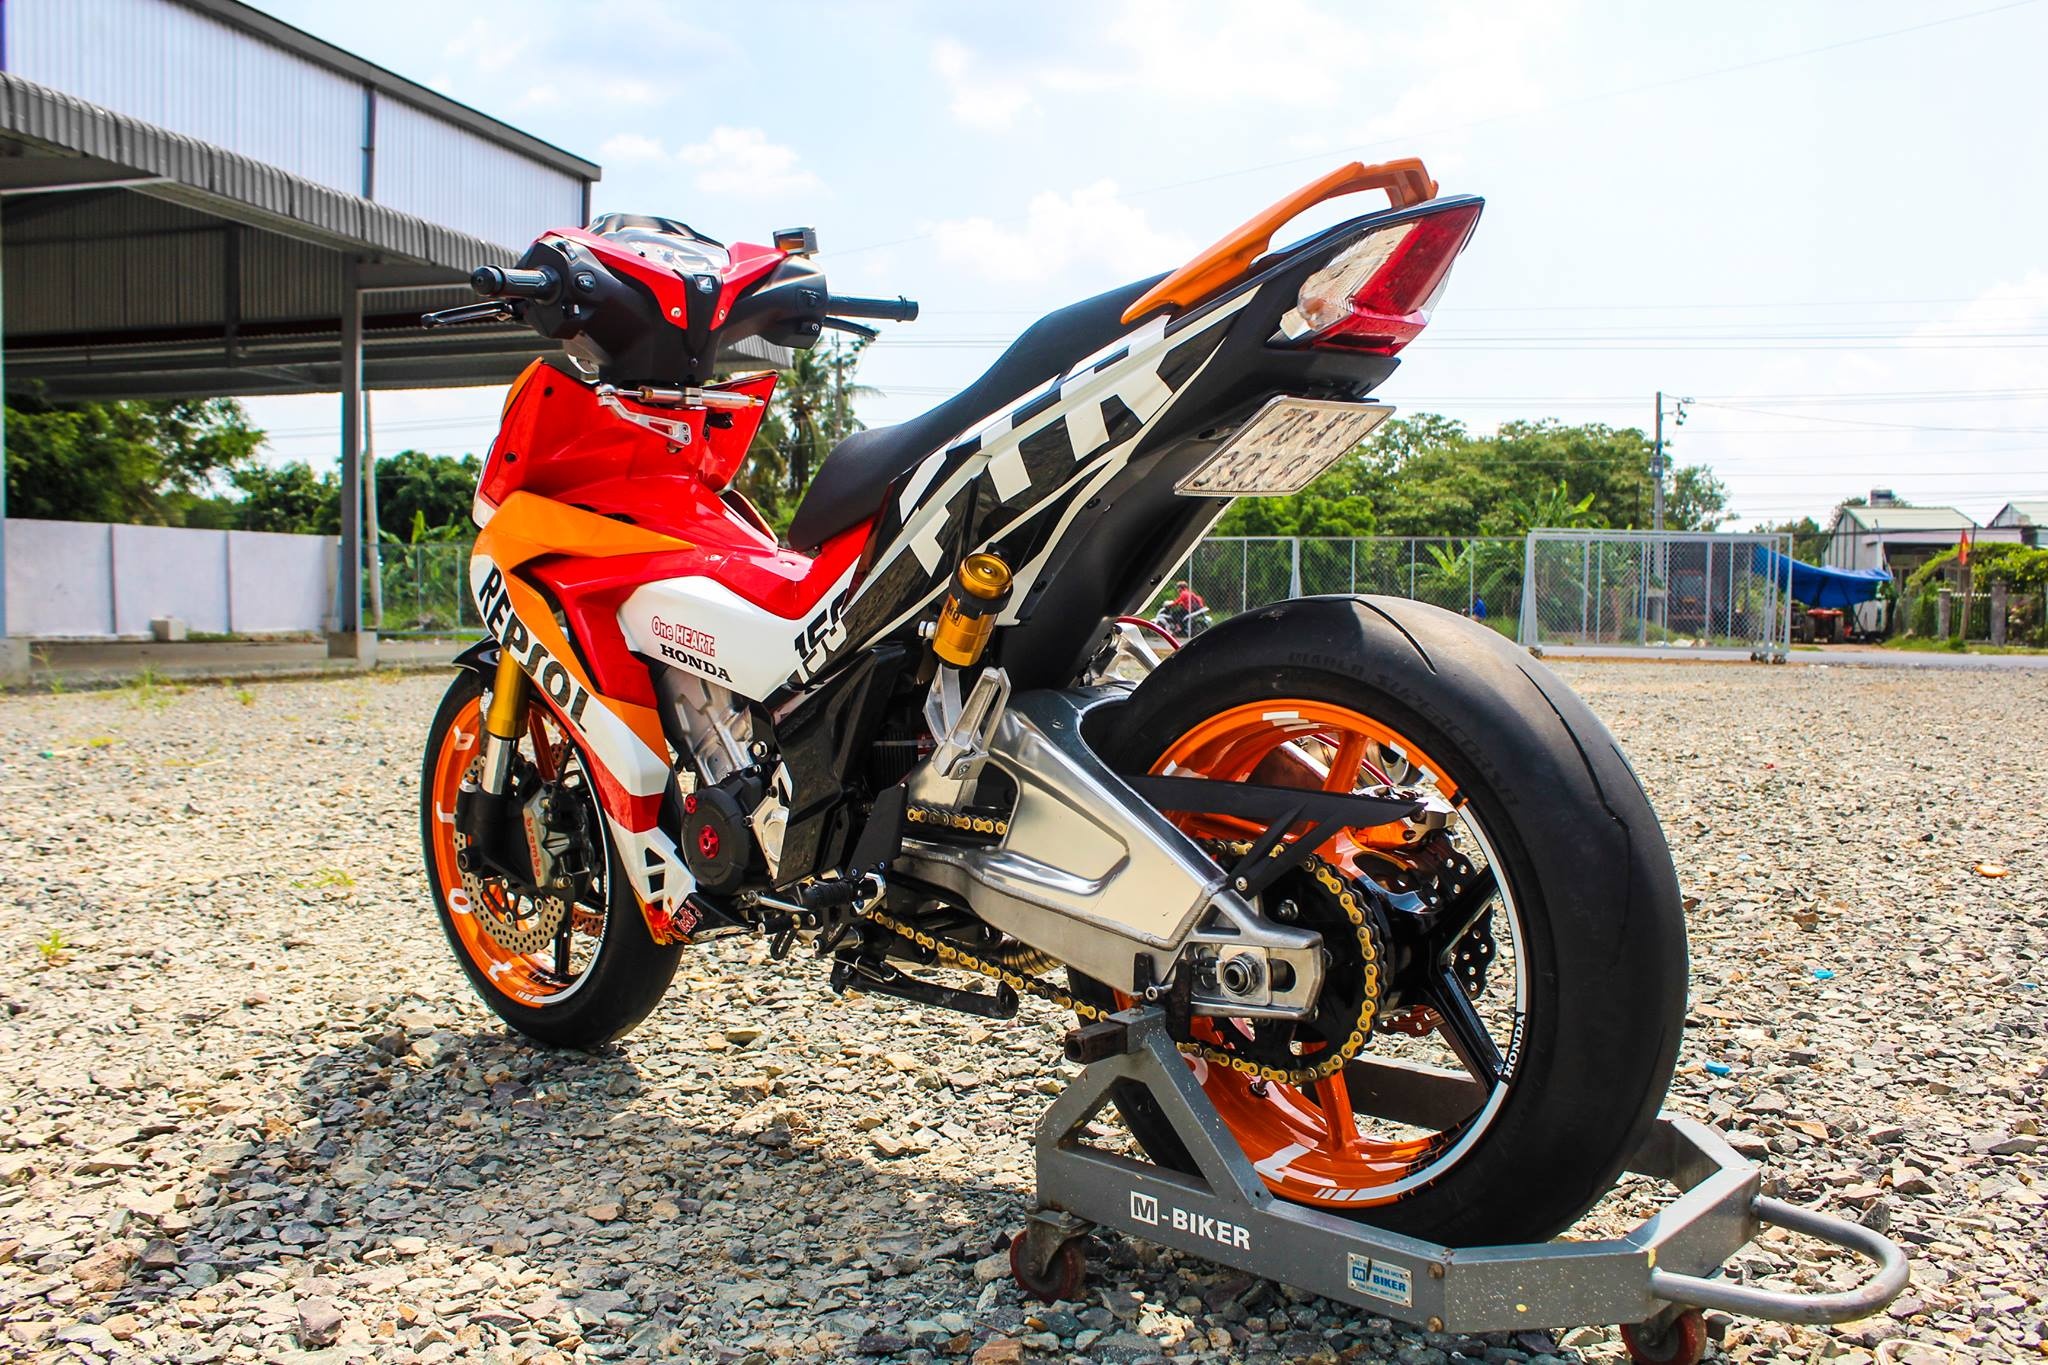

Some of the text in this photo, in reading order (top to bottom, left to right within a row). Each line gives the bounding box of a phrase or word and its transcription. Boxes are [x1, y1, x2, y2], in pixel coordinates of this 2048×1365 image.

[479, 562, 589, 733] REPSOL
[652, 615, 673, 641] One
[660, 643, 733, 683] HONDA
[526, 816, 542, 878] brembo
[1503, 1014, 1526, 1079] HONDA
[1373, 1274, 1407, 1293] BIKER
